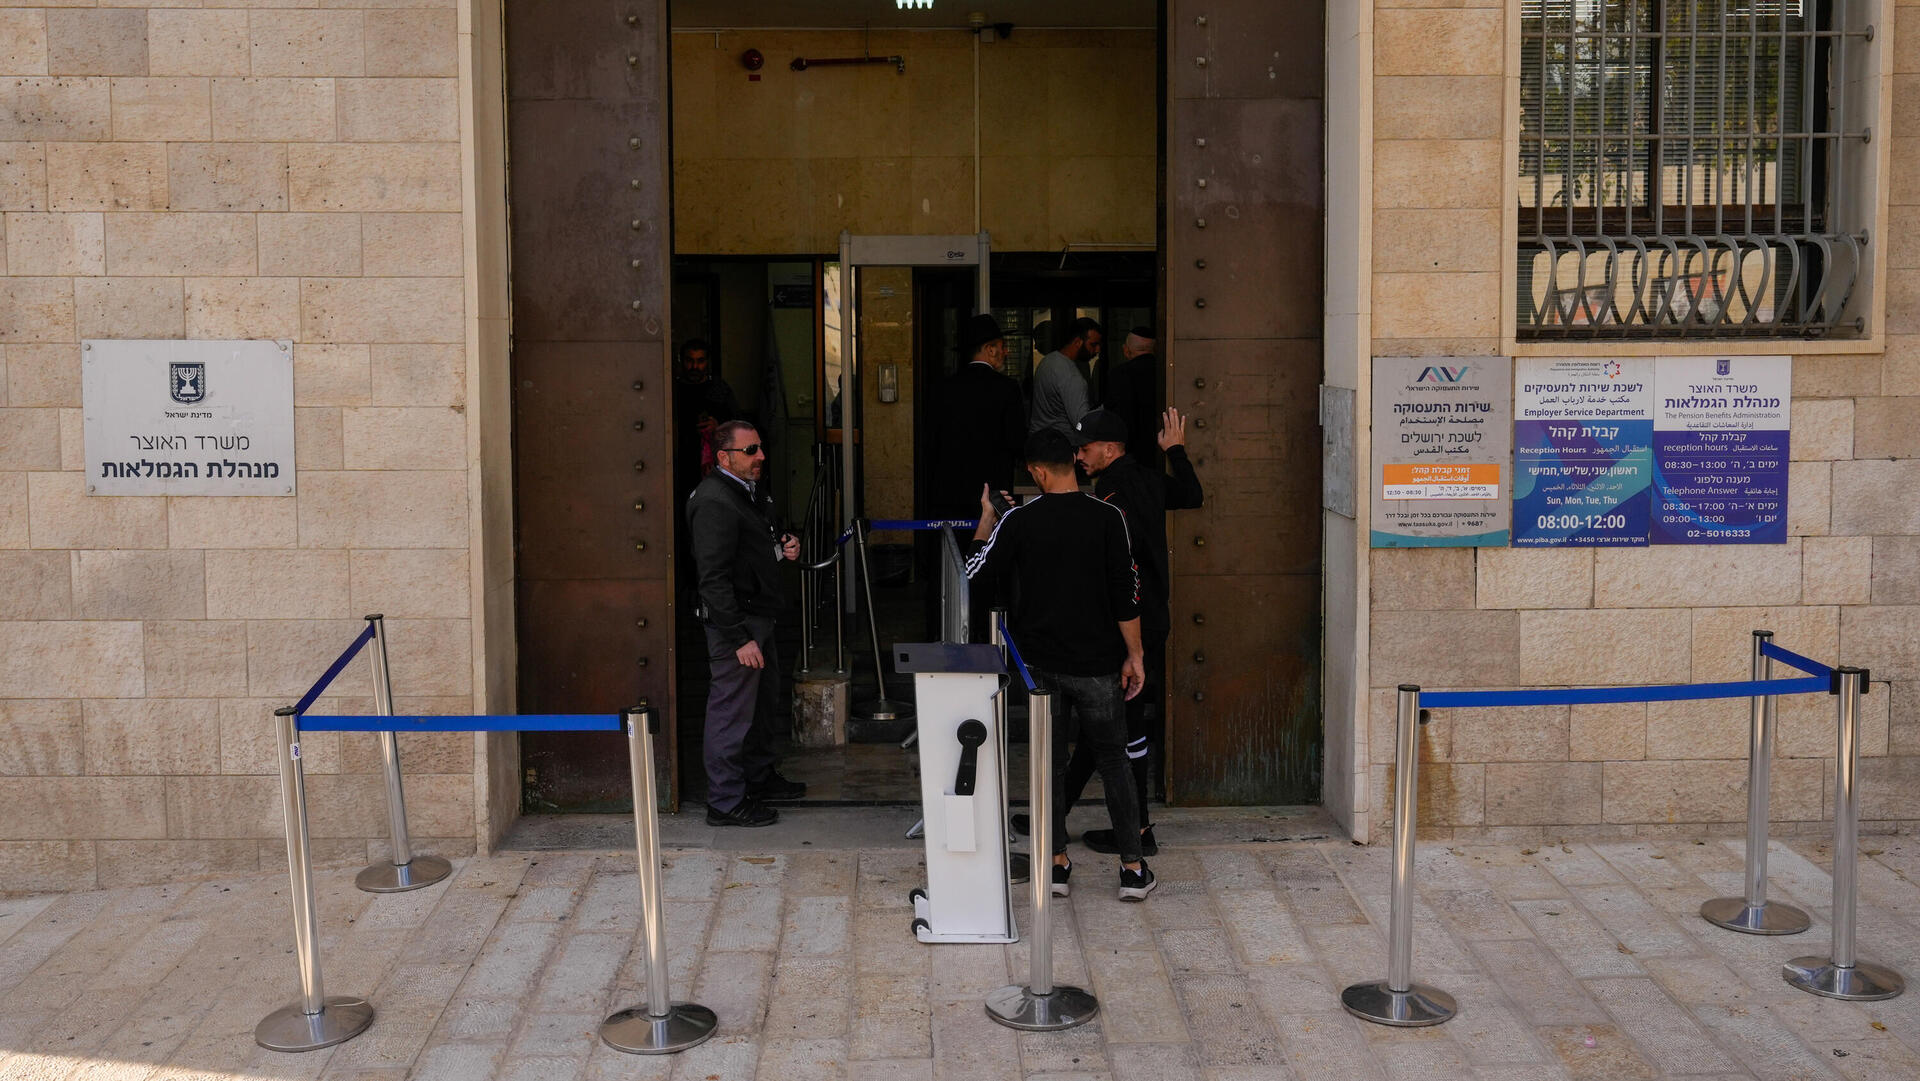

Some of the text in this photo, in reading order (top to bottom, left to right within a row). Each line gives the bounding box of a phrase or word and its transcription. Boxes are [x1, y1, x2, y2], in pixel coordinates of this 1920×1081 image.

[1525, 383, 1642, 394] לשכת שירות למעסיקים
[1689, 385, 1757, 393] משרד האוצר
[1540, 396, 1559, 404] العمل
[1610, 395, 1630, 405] مكتب
[1665, 396, 1780, 408] מנהלת הגמלאות
[1394, 403, 1490, 415] שירות התעסוקה
[1525, 409, 1562, 417] Employer
[1596, 409, 1644, 417] Department
[1448, 415, 1484, 423] مصلحة
[1402, 431, 1481, 442] לשכת ירושלים
[1549, 426, 1619, 440] קבלת קהל
[1700, 432, 1746, 442] קבלת קהל
[131, 436, 250, 450] משרד האוצר
[1414, 446, 1469, 456] مكتب القدس
[1520, 447, 1560, 455] Reception
[1664, 444, 1703, 454] reception
[102, 459, 279, 478] מנהלת הגמלאות
[1694, 475, 1750, 484] מענה טלפוני
[1663, 487, 1705, 496] Telephone
[1547, 496, 1617, 505] Sun, Mon, Tue, Thu
[1538, 515, 1625, 528] 08:00-12:00
